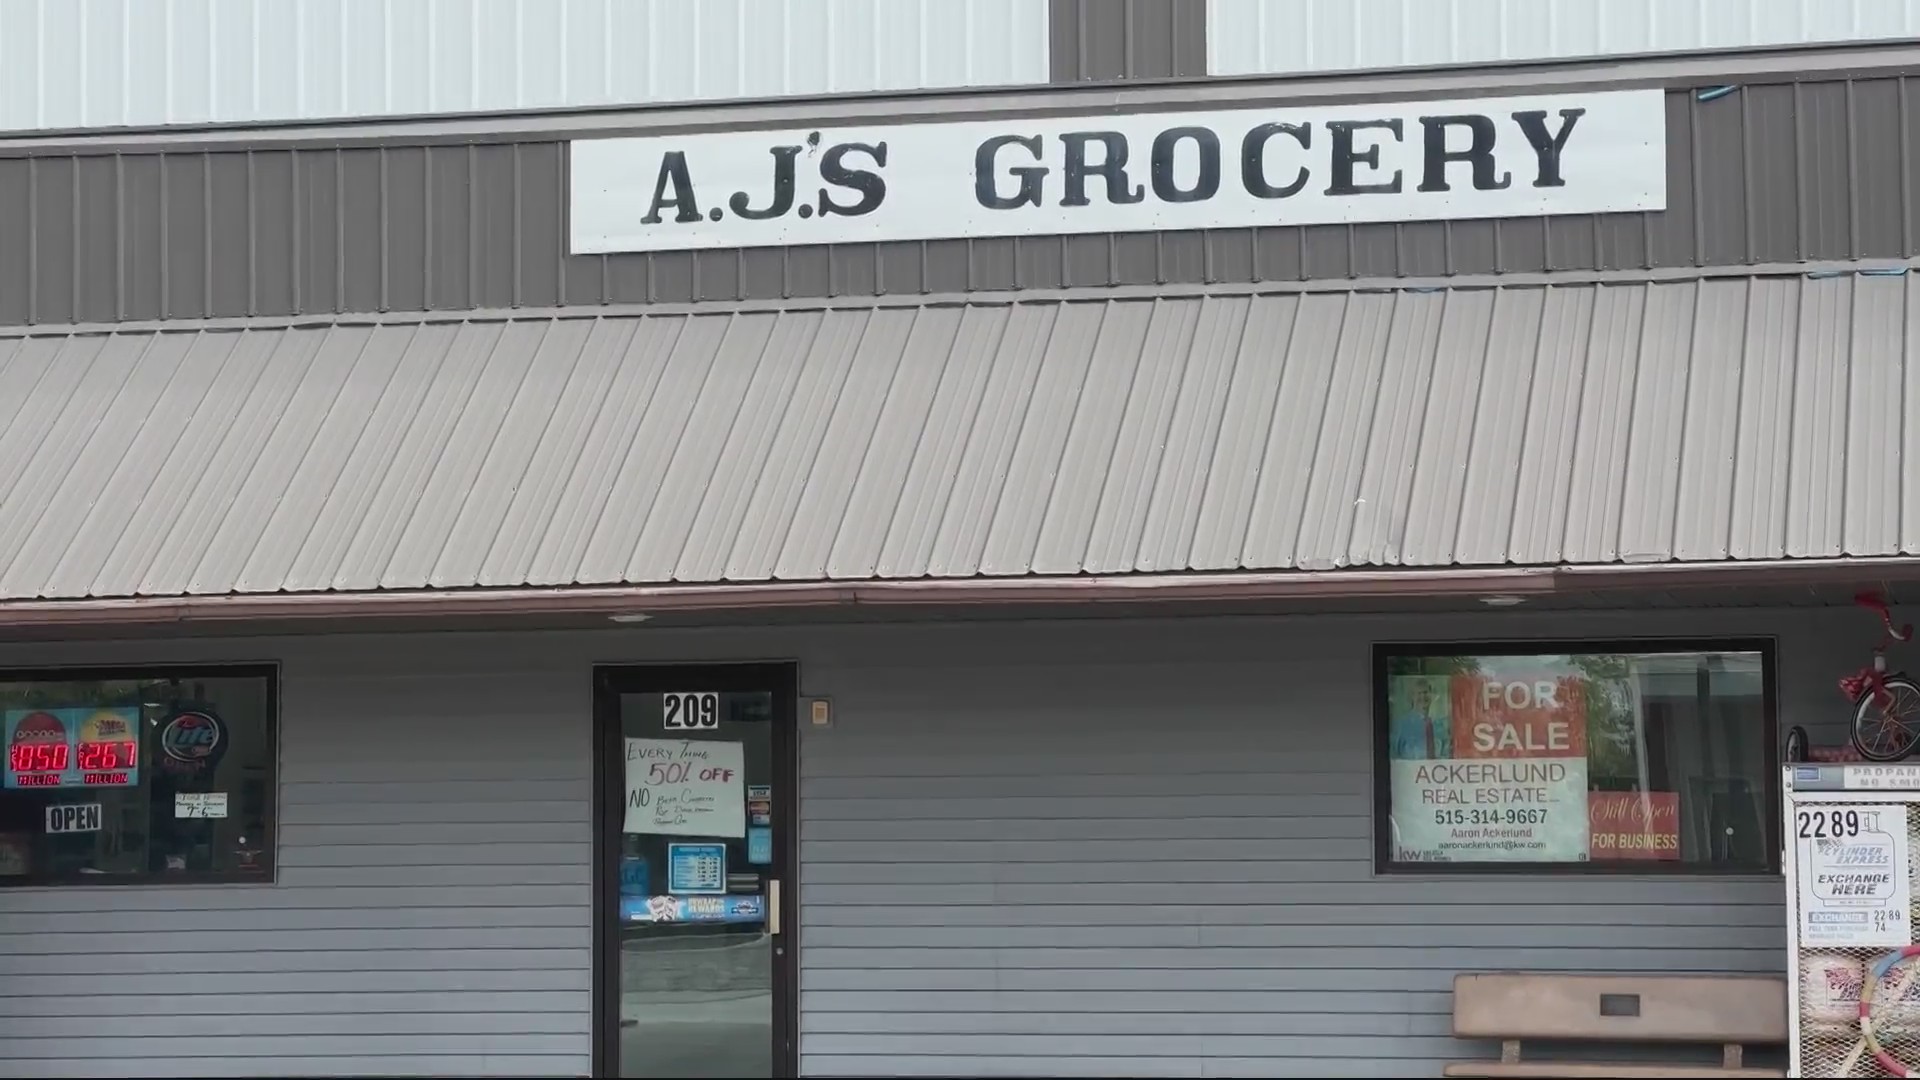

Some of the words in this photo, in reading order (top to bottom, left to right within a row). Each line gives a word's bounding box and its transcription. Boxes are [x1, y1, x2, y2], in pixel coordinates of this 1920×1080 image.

[974, 108, 1587, 210] GROCERY
[1482, 680, 1562, 710] FOR
[664, 693, 717, 729] 209
[1472, 722, 1570, 751] SALE
[85, 743, 135, 768] 267
[85, 774, 127, 784] MILLION
[644, 761, 692, 786] 50%
[700, 767, 735, 783] OFF
[1415, 763, 1566, 785] ACKERLUND
[1853, 767, 1920, 776] PROPAN
[18, 775, 60, 785] MILLION
[629, 787, 650, 808] NO
[1421, 789, 1470, 804] REAL
[1475, 788, 1548, 803] ESTATE
[50, 806, 99, 831] OPEN
[1435, 809, 1548, 825] 515-314-9667
[1451, 828, 1480, 838] Aaron
[1482, 828, 1532, 838] Ackerlund
[1592, 833, 1616, 848] FOR
[1619, 833, 1678, 849] BUSINESS
[1824, 847, 1883, 856] CYLINDER
[1836, 856, 1889, 864] EXPRESS
[1818, 874, 1889, 883] EXCHANGE
[1831, 884, 1877, 895] HERE
[1875, 922, 1886, 932] 74
